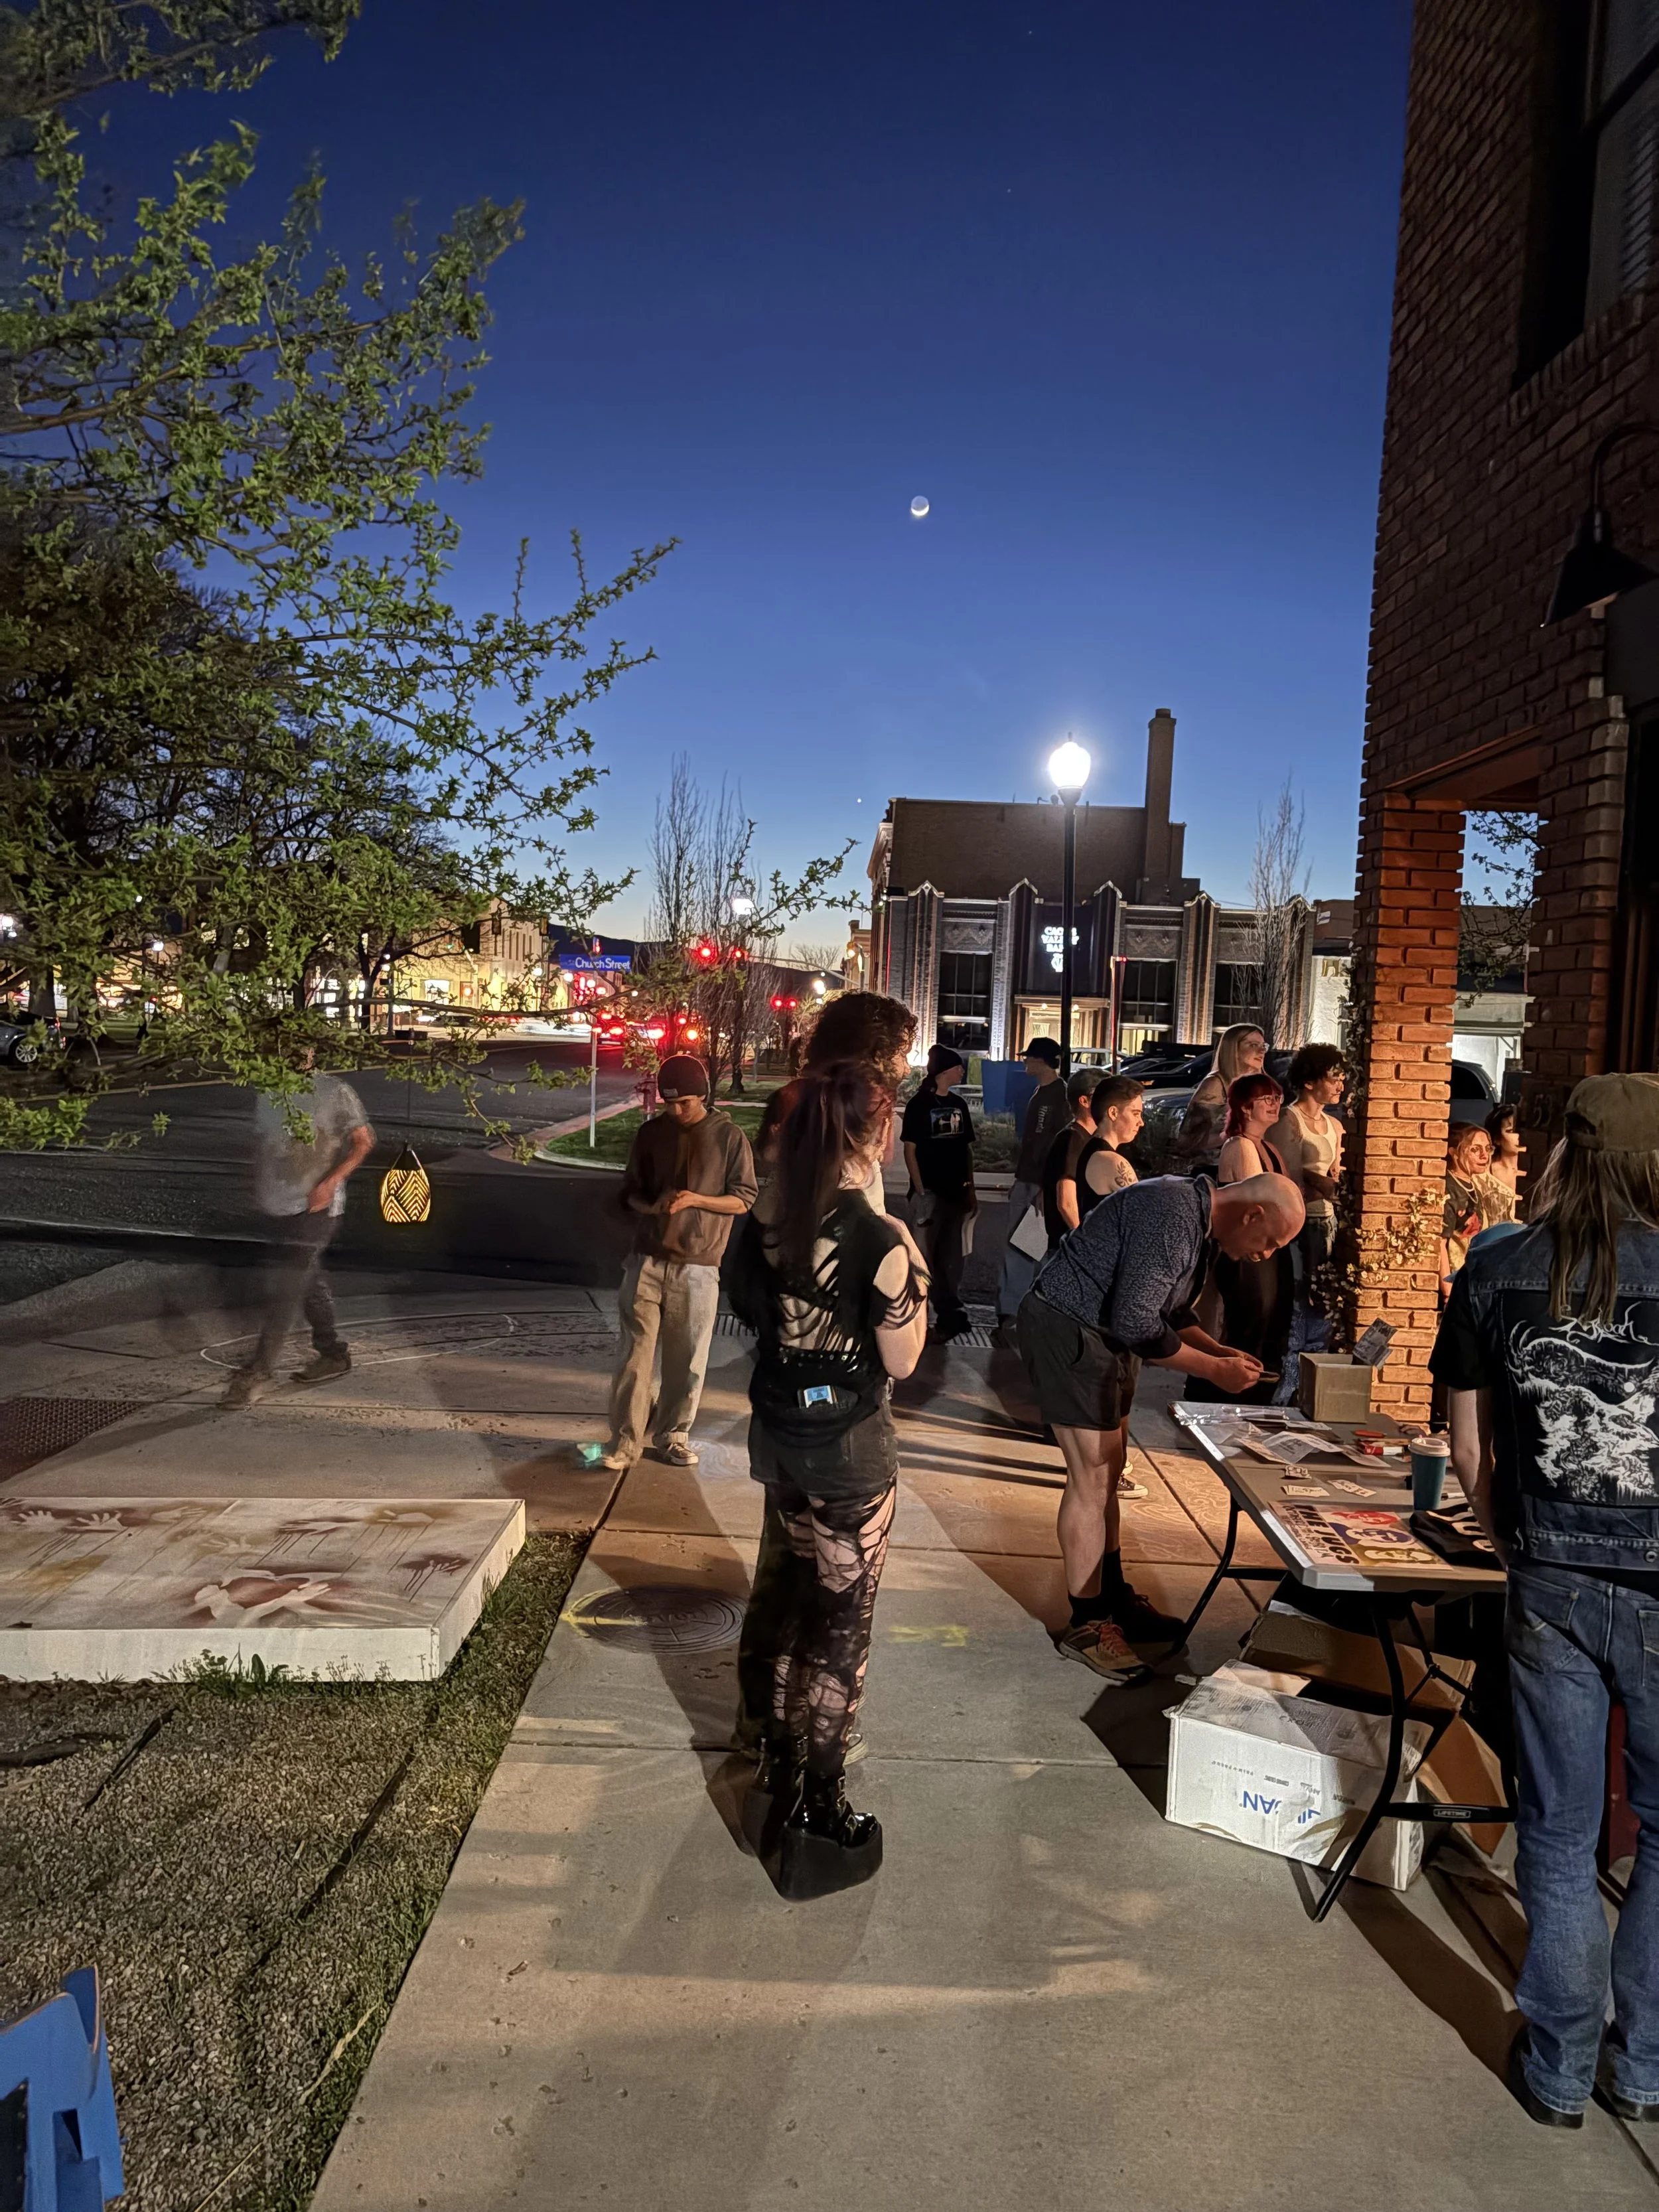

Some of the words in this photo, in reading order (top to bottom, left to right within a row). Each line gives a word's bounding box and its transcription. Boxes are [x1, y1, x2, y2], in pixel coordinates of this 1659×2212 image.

[575, 957, 605, 969] Church
[605, 958, 630, 969] Street
[1293, 1504, 1329, 1528] THE
[1313, 1529, 1360, 1564] JUGS
